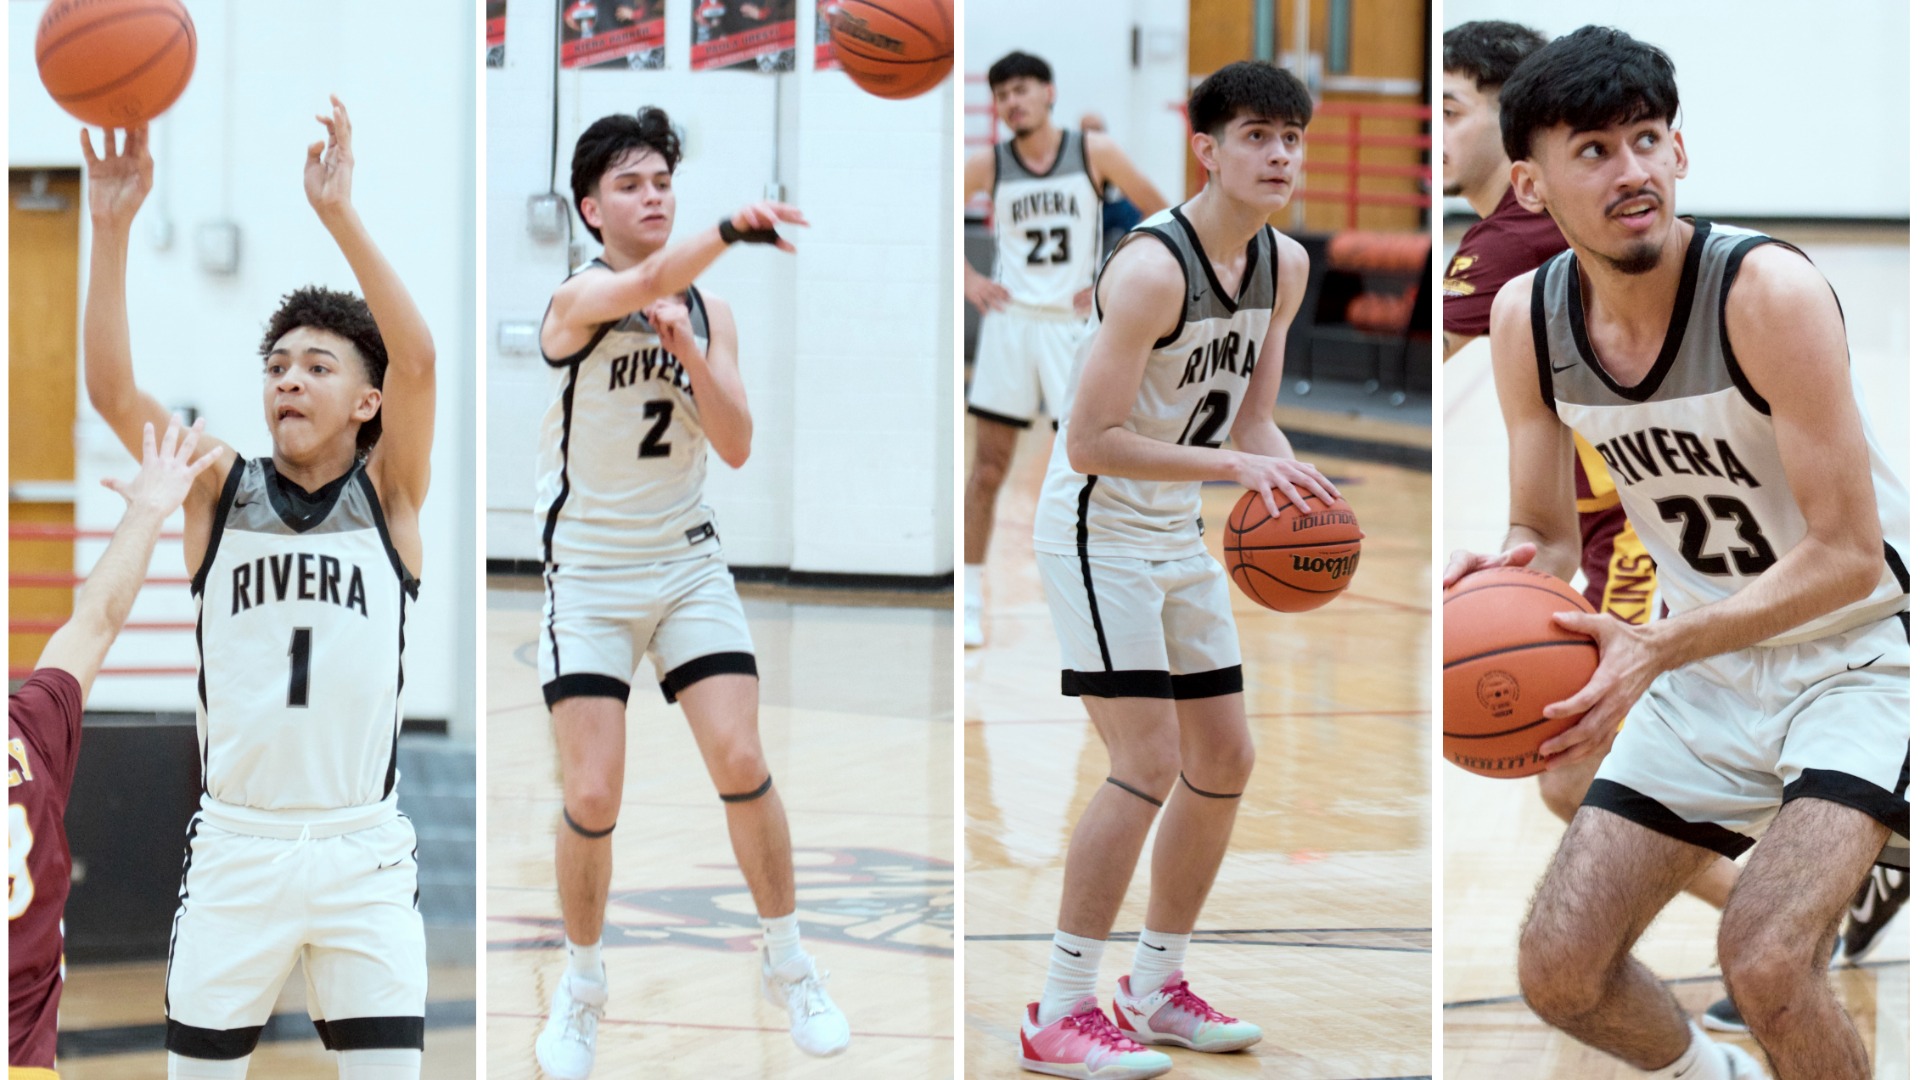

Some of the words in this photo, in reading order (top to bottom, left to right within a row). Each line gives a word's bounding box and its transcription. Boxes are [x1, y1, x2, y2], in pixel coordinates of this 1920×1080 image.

[1012, 189, 1081, 225] RIVERA
[1025, 226, 1070, 264] 23
[1176, 330, 1255, 390] RIVRA
[637, 399, 674, 459] 2
[1595, 427, 1762, 488] RIVERA
[1651, 494, 1778, 577] 23
[231, 552, 368, 619] RIVERA
[286, 627, 313, 708] 1
